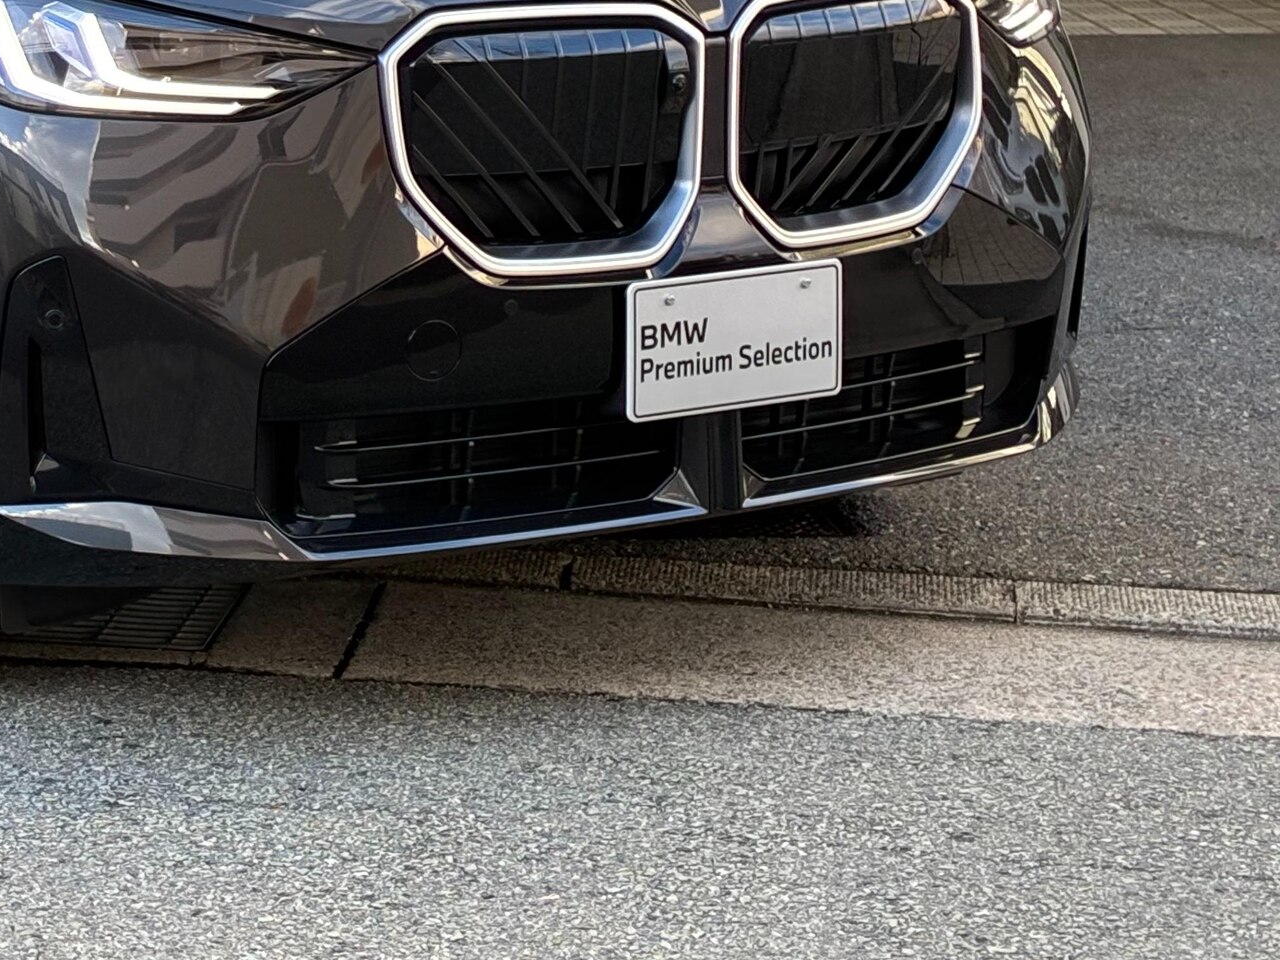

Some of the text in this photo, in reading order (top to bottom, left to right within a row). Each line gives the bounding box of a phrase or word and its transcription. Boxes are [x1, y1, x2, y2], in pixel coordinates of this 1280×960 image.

[641, 317, 709, 351] BMW
[640, 337, 833, 383] Premium Selection
